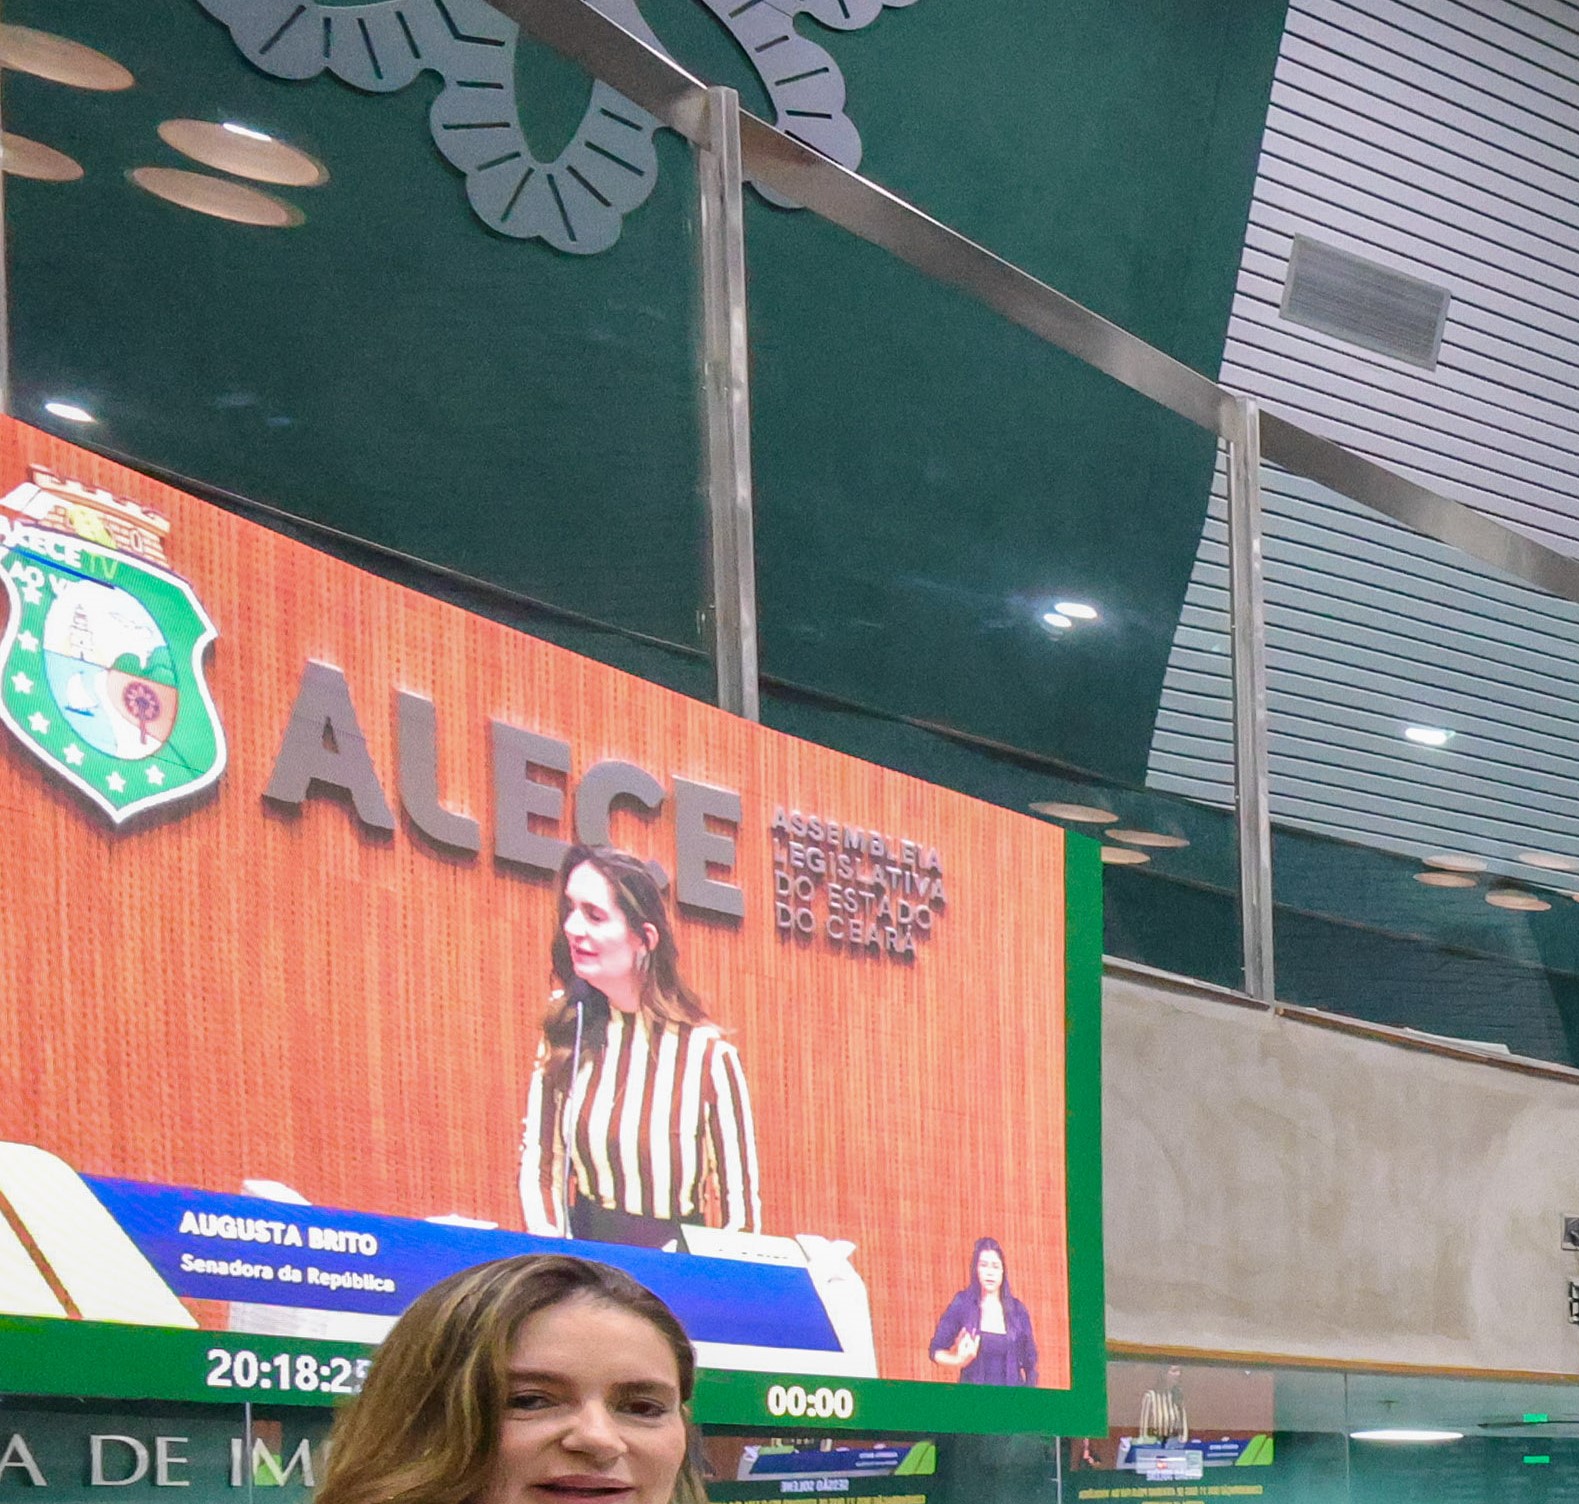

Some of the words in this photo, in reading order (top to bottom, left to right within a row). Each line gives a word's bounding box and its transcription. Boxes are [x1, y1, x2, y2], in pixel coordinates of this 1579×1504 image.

[261, 658, 745, 919] ALECE
[771, 806, 942, 873] ASSEMBLEIA
[773, 838, 946, 902] LEGISLATIVA
[775, 869, 815, 901] DO
[828, 882, 932, 930] ESTADO
[776, 901, 816, 933] DO
[826, 915, 915, 953] CEARÁ
[179, 1211, 303, 1247] AUGUSTA
[308, 1227, 378, 1256] BRITO
[180, 1253, 273, 1280] Senadora
[278, 1265, 302, 1282] da
[307, 1267, 395, 1292] República
[767, 1385, 853, 1418] 00:00
[90, 1435, 190, 1486] DE
